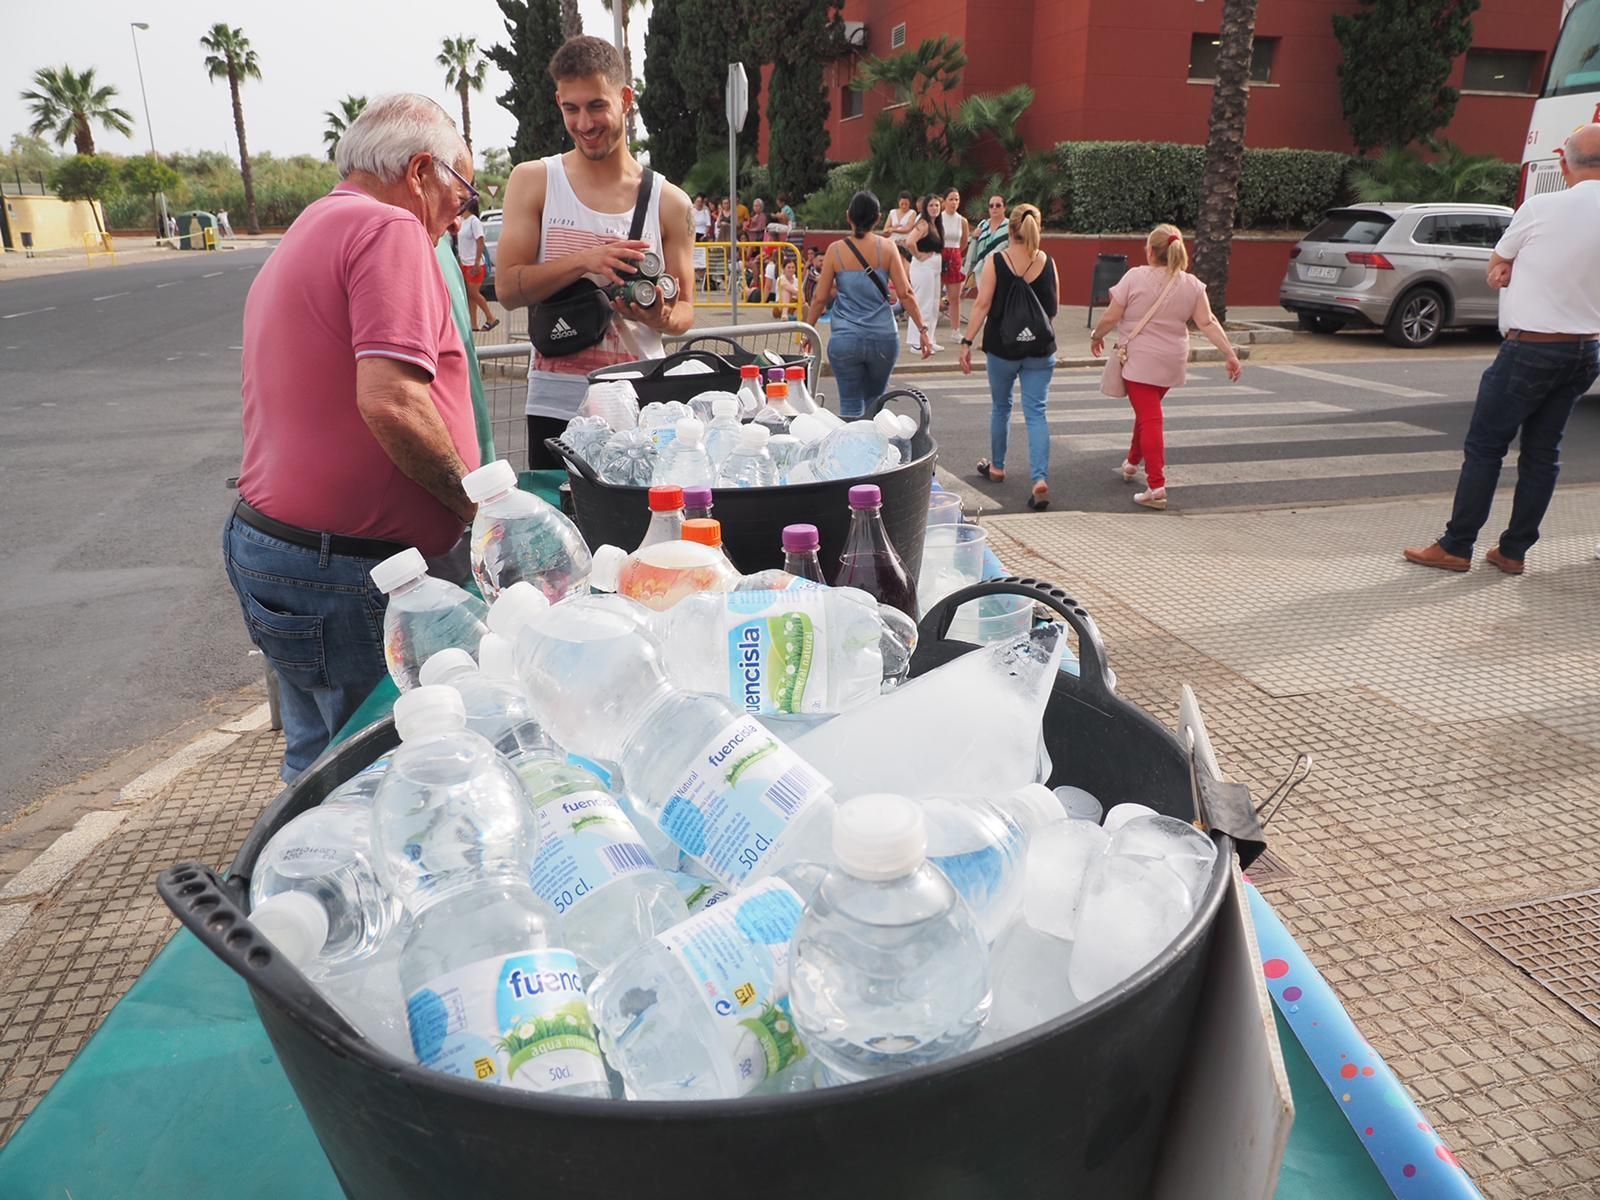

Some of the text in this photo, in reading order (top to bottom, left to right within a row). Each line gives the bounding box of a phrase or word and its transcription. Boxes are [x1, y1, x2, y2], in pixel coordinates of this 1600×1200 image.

[550, 328, 578, 340] adidas
[803, 631, 814, 666] natural
[708, 723, 758, 768] fuencisla
[677, 770, 699, 797] Natural
[738, 832, 774, 870] 50 cl.
[554, 877, 594, 914] 50 cl.
